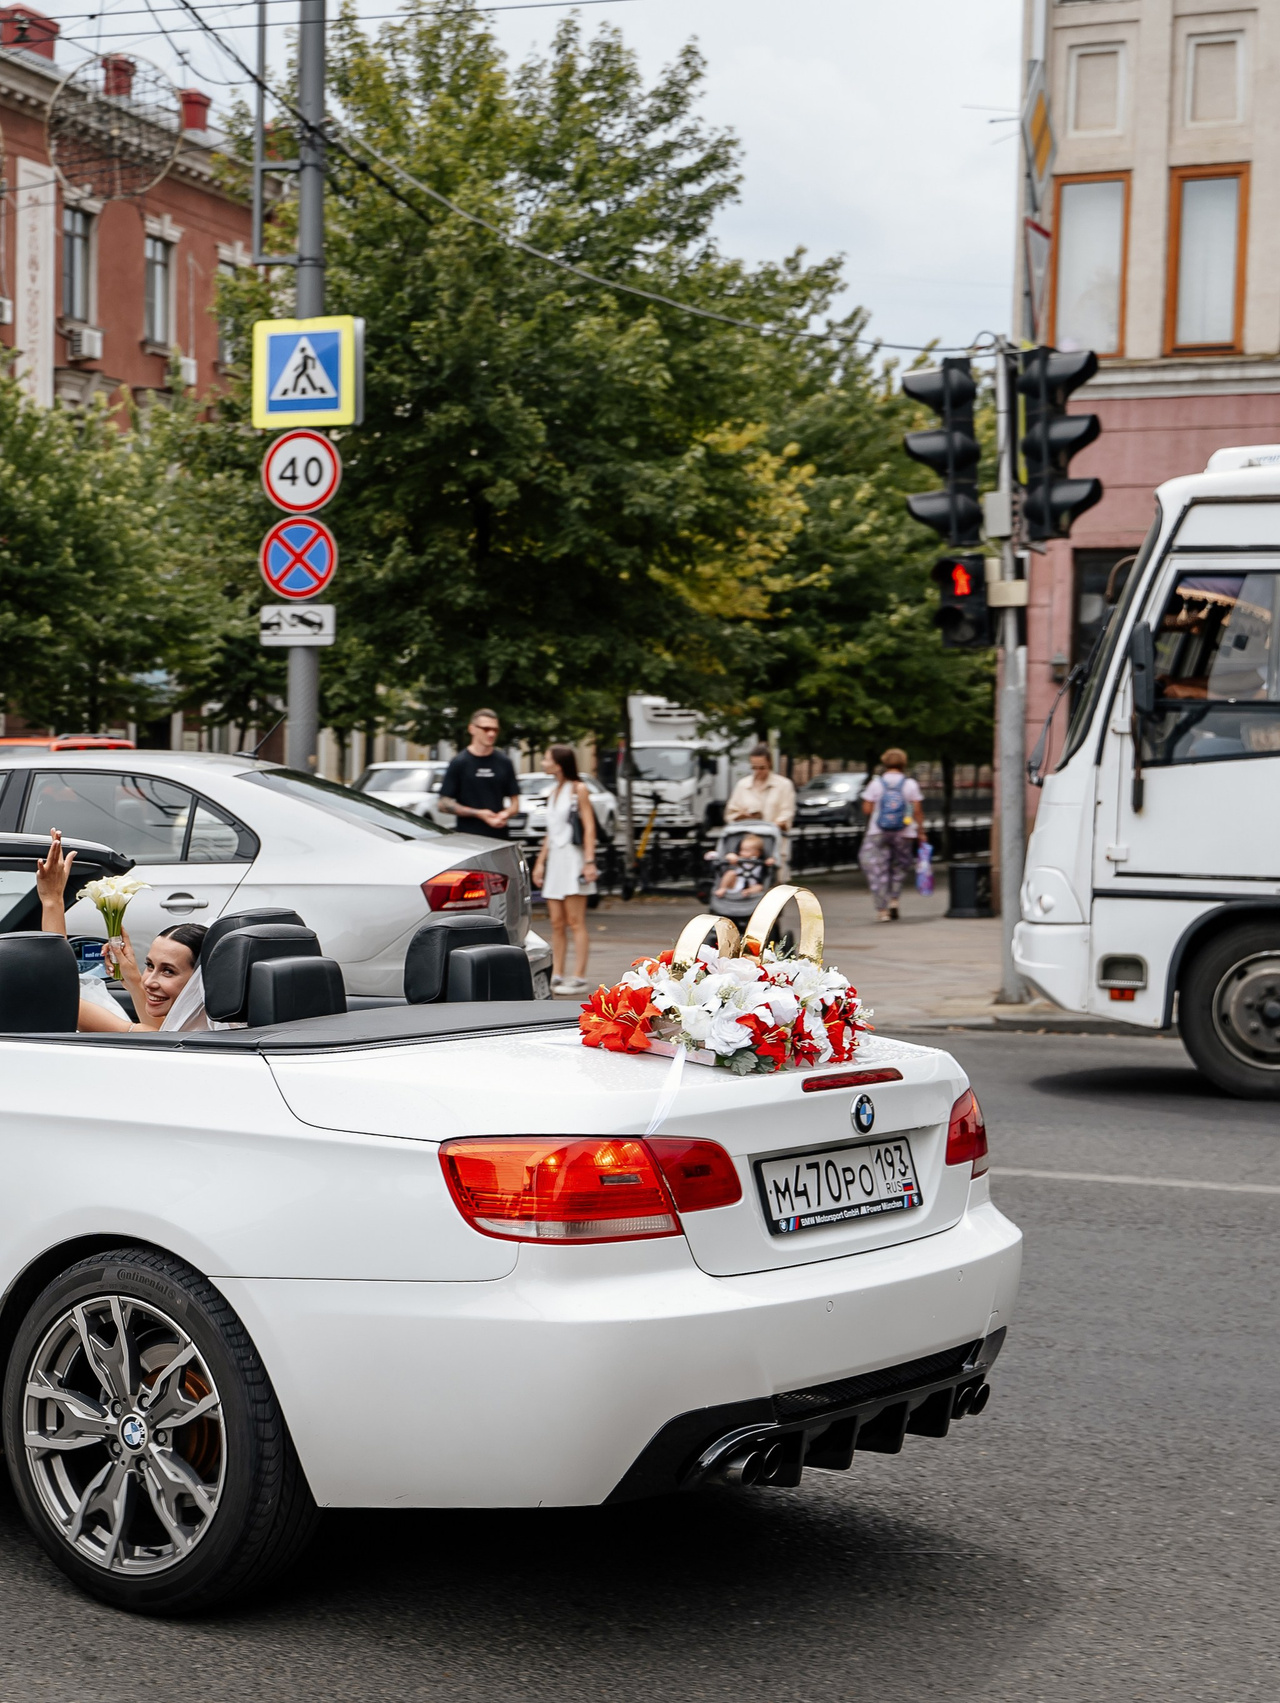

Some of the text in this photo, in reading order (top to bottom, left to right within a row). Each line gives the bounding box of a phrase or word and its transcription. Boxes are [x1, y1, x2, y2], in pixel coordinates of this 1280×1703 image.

[278, 456, 323, 487] 40
[874, 1144, 907, 1181] 193
[886, 1180, 903, 1194] RUS
[800, 1217, 815, 1227] BMW
[815, 1211, 844, 1225] Motorsport
[844, 1209, 860, 1219] GmbH
[116, 1268, 169, 1295] Continental
